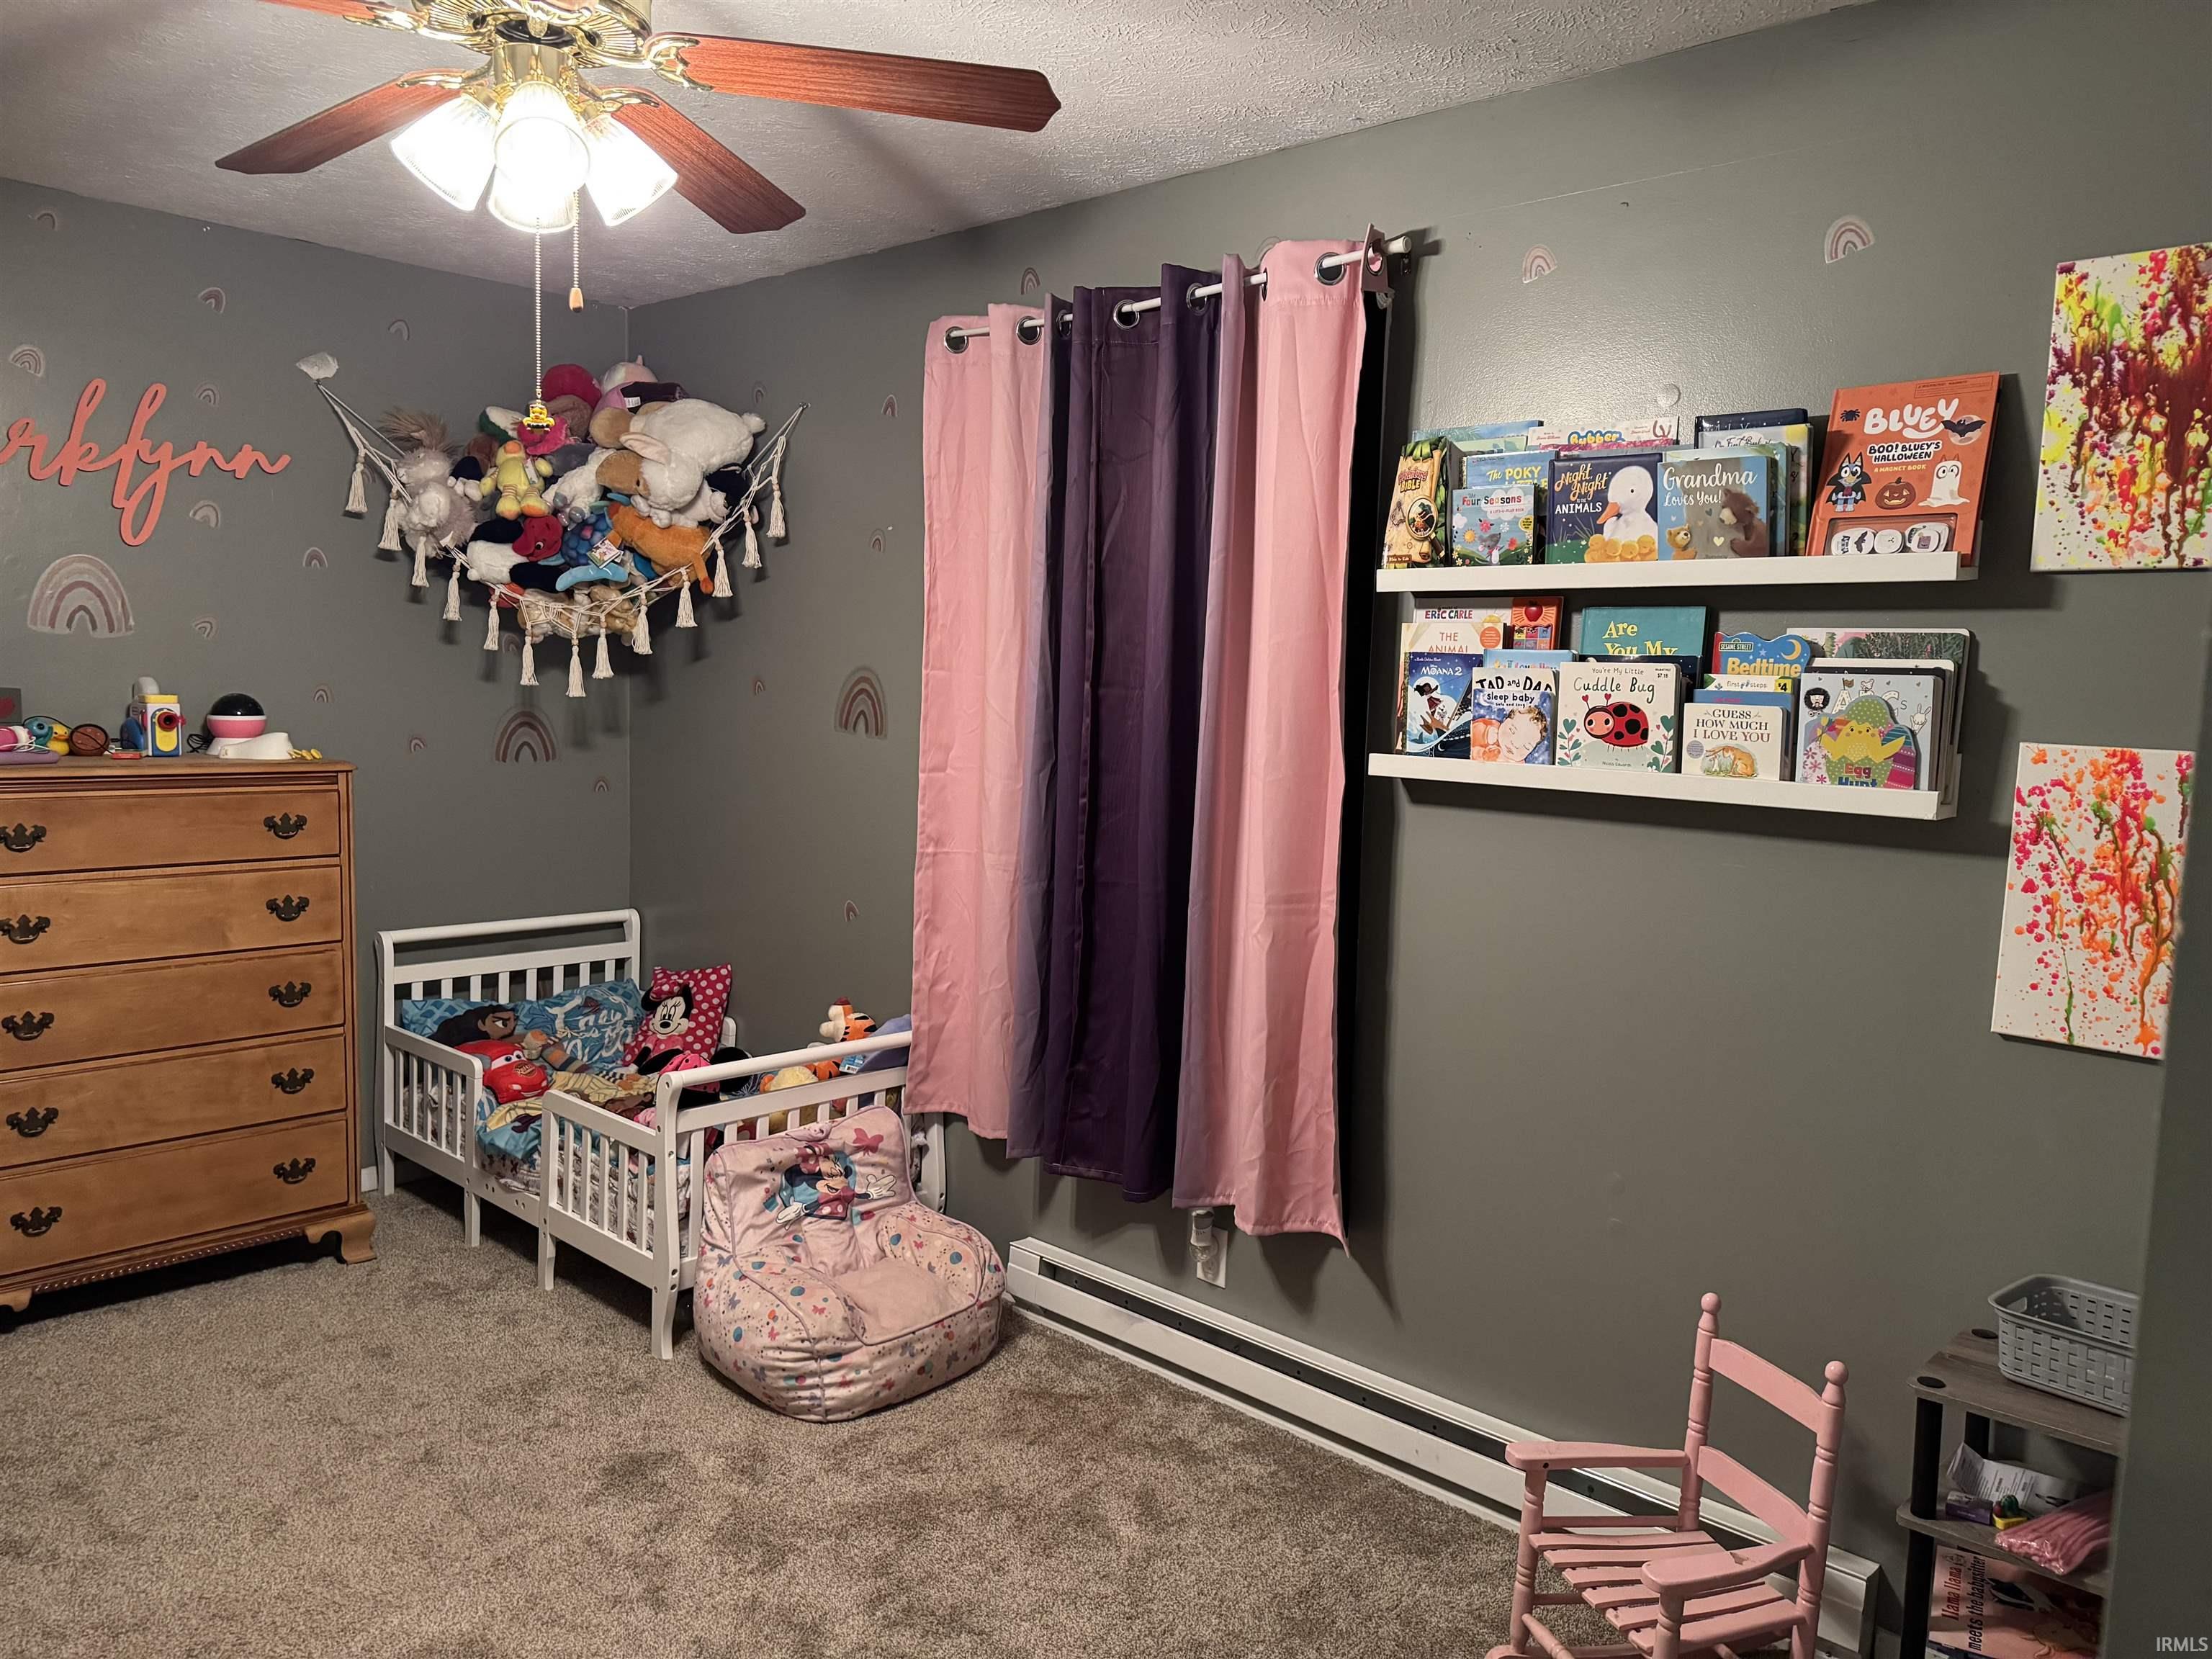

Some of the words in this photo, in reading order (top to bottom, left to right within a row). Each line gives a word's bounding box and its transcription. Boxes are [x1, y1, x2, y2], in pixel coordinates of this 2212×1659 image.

[1863, 398, 1959, 439] BLUEY
[1570, 432, 1619, 445] Rubber
[1869, 444, 1899, 454] BOO!
[1901, 441, 1941, 452] BLUEY'S
[1874, 451, 1933, 463] HALLOWEEN
[1486, 469, 1502, 482] The
[1505, 466, 1542, 480] POKY
[1663, 463, 1758, 490] Grandma
[1400, 479, 1421, 493] BIBLE
[1570, 472, 1608, 501] Night
[1462, 496, 1480, 506] Four
[1484, 495, 1521, 505] Seasons
[1664, 492, 1694, 506] Loves
[1697, 490, 1722, 505] You!
[1555, 502, 1602, 514] ANIMALS
[1425, 610, 1447, 619] ERIC
[1448, 610, 1473, 619] CARLE
[1439, 632, 1458, 642] THE
[1602, 621, 1638, 639] Are
[1421, 666, 1454, 675] MOANA
[1455, 666, 1462, 675] 2
[1727, 657, 1802, 678] Bedtime
[1475, 676, 1504, 689] TAD
[1778, 683, 1787, 691] $4
[1574, 677, 1621, 692] Cuddle
[1629, 678, 1655, 703] Bug
[1487, 692, 1509, 703] sleep
[1512, 693, 1534, 704] baby
[1712, 709, 1752, 719] GUESS
[1696, 719, 1725, 729] HOW
[1730, 721, 1768, 731] MUCH
[1694, 729, 1697, 738] I
[1703, 729, 1737, 740] LOVE
[1741, 732, 1771, 742] YOU
[1845, 763, 1871, 778] Egg
[1944, 1567, 1962, 1591] llama
[1966, 1556, 1986, 1599] babysitter
[1941, 1591, 1960, 1621] llama
[1966, 1599, 1984, 1617] the
[1967, 1617, 1983, 1651] meets
